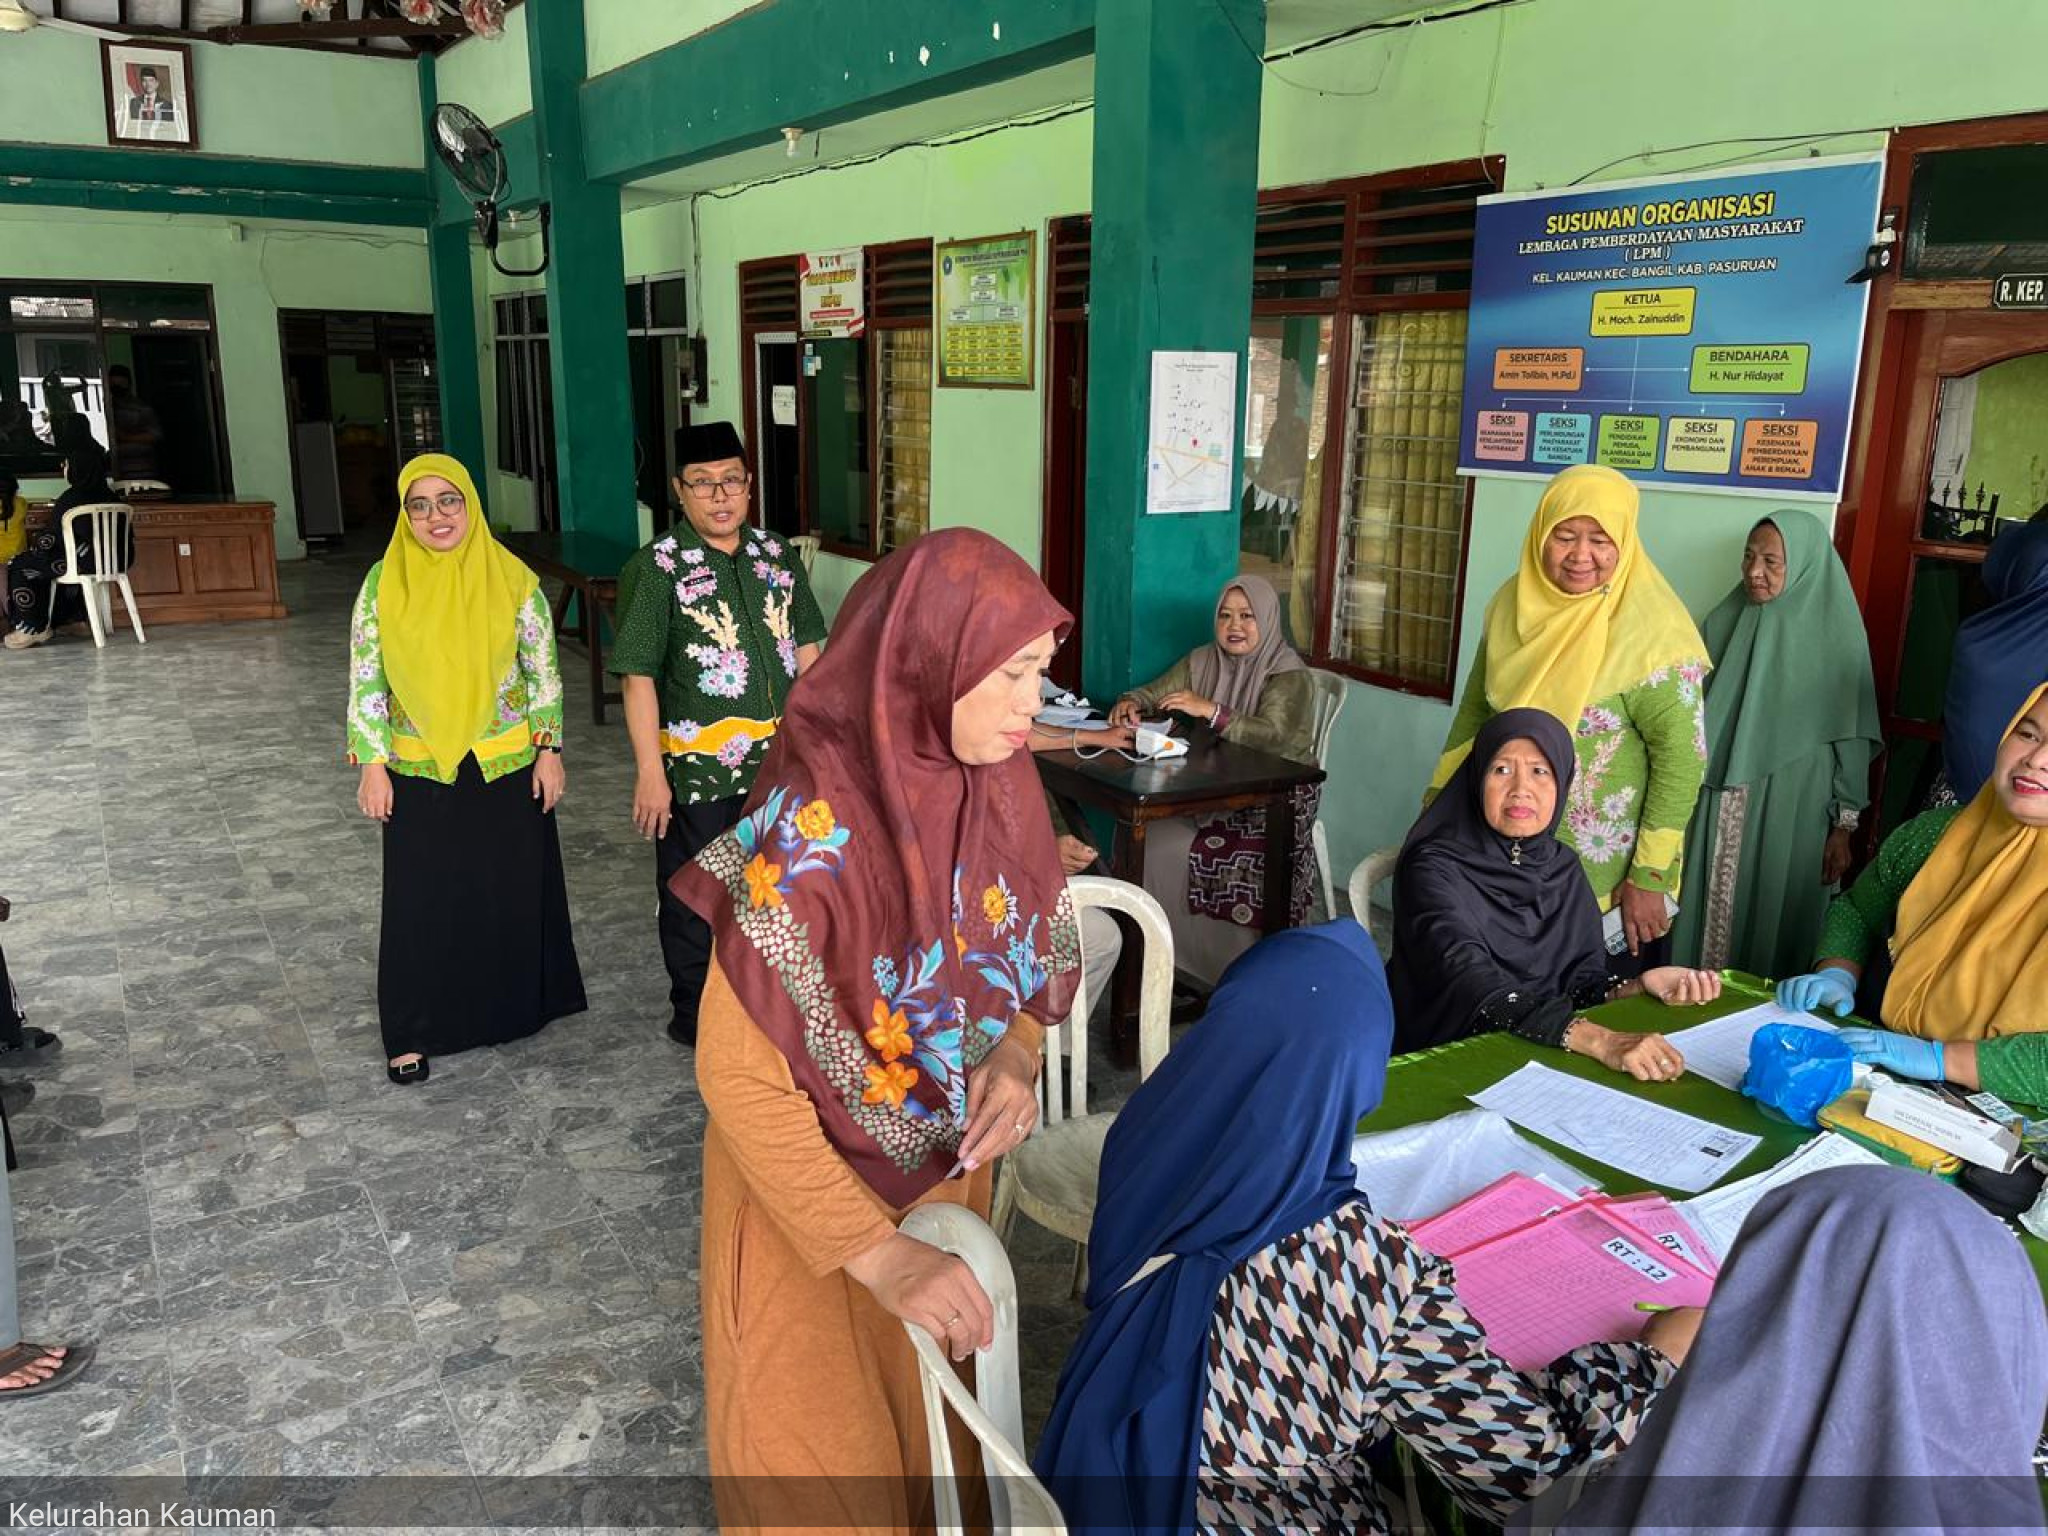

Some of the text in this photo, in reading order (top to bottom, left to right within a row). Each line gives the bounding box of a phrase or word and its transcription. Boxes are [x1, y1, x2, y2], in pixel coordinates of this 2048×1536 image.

[1545, 192, 1775, 235] SUSUNAN ORGANISASI
[1519, 219, 1804, 254] LEMBAGA PEMBERDAYAAN MASYARAKAT
[1556, 269, 1602, 283] KAUMAN
[1604, 267, 1629, 280] KEC.
[1631, 265, 1674, 279] BANGIL
[1677, 262, 1705, 276] KAB.
[1708, 257, 1777, 274] PASURUAN
[2000, 281, 2044, 302] R. KEP.
[1623, 292, 1662, 305] KETUA
[1609, 314, 1636, 326] Moch.
[1638, 311, 1686, 325] Zainuddin
[1509, 352, 1569, 363] SEKRETARIS
[1709, 349, 1790, 362] BENDAHARA
[1499, 370, 1519, 380] Amin
[1709, 370, 1785, 382] H. Nur Hidayat
[1489, 414, 1516, 425] SEKSI
[1548, 417, 1577, 429] SEKSI
[1613, 420, 1644, 431] SEKSI
[1684, 421, 1718, 433] SEKSI
[1762, 423, 1799, 436] SEKSI
[1658, 1234, 1684, 1254] RT
